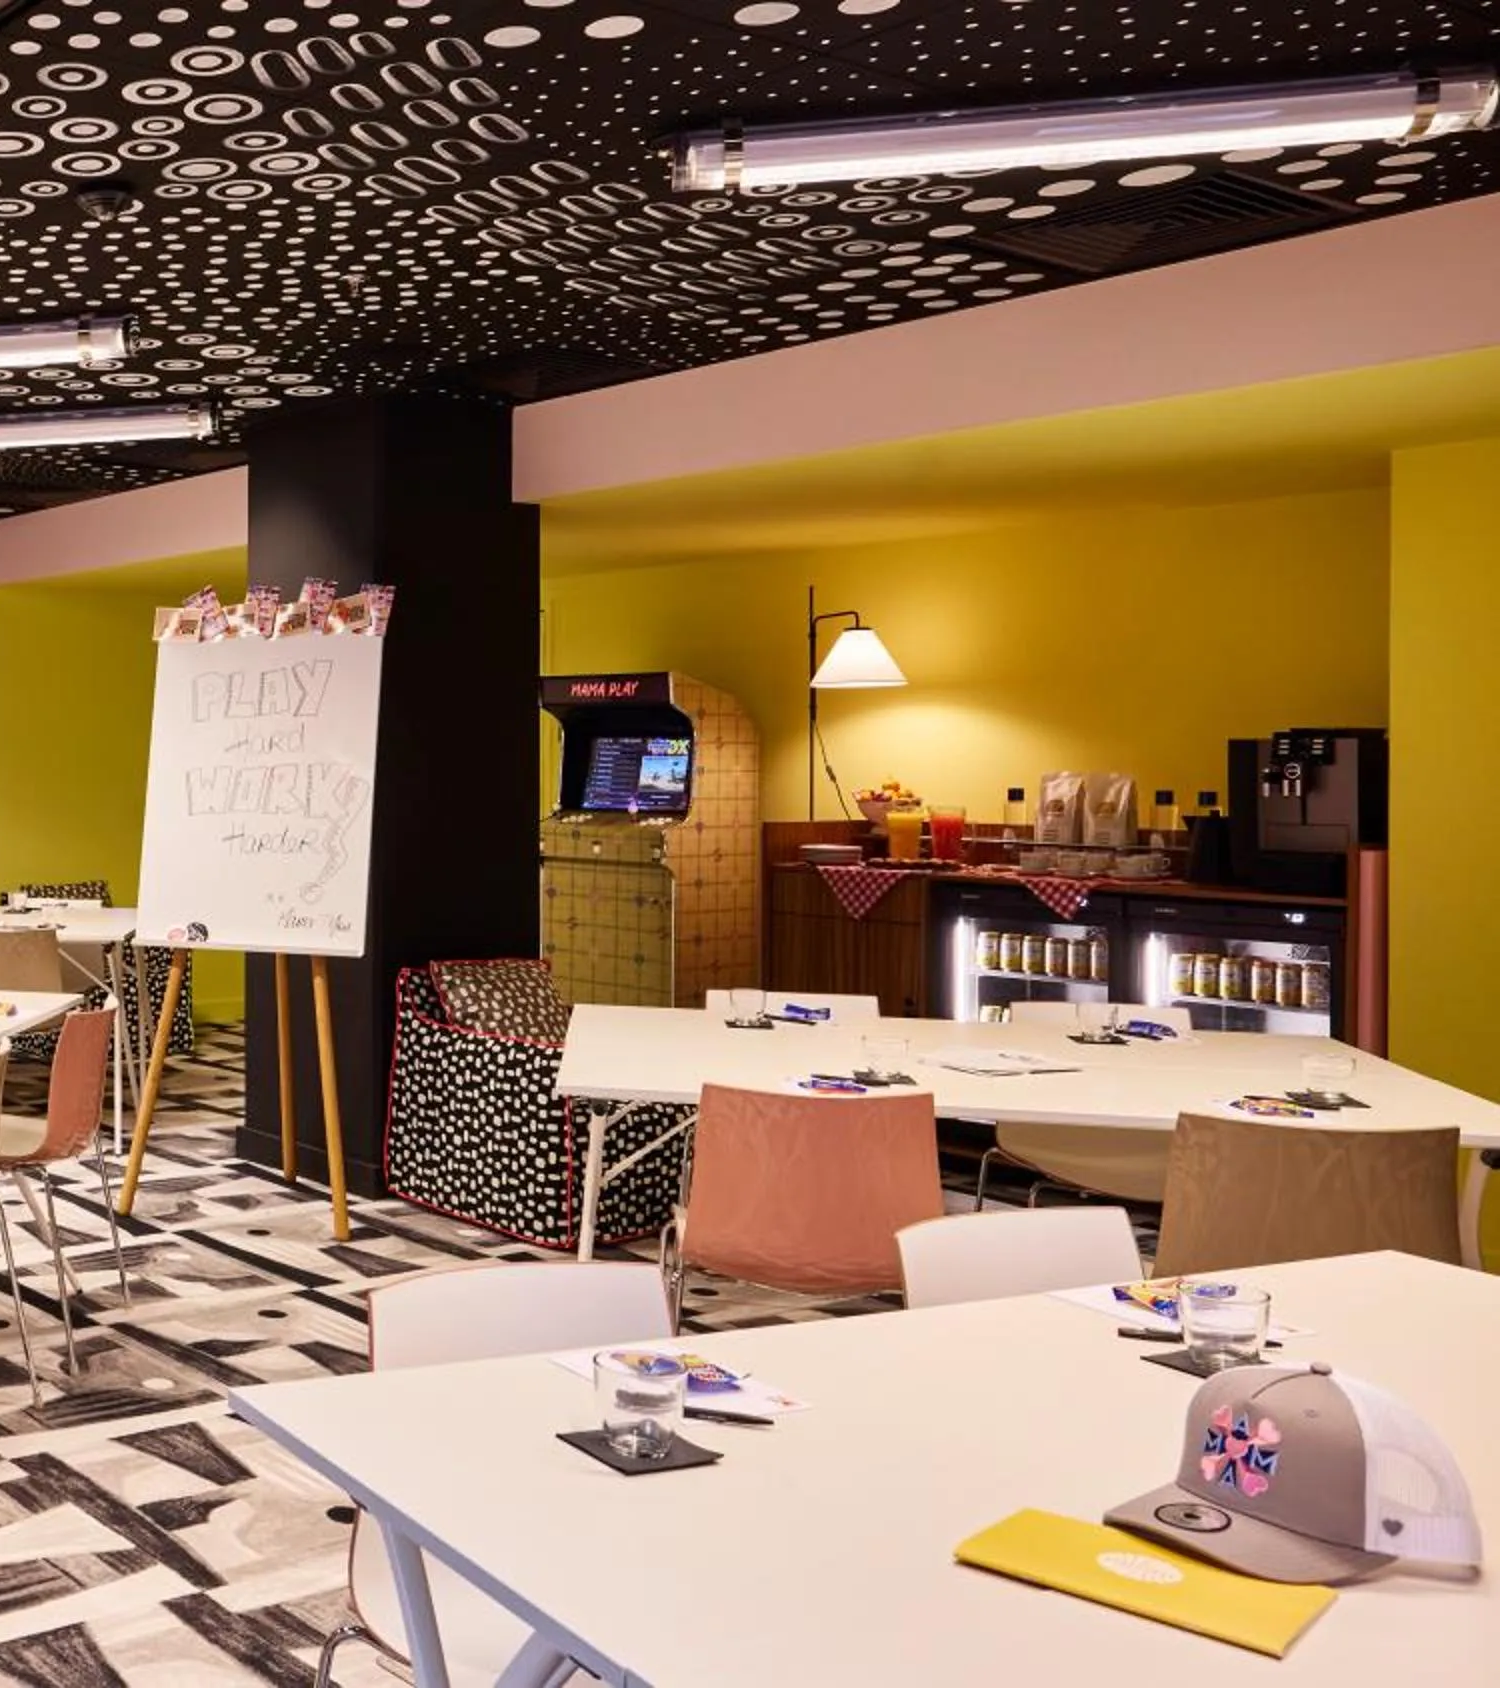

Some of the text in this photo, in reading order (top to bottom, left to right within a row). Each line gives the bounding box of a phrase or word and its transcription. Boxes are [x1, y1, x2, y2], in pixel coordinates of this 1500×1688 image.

[191, 659, 334, 723] PLAY
[570, 679, 640, 698] MAMA PLAY
[185, 763, 354, 819] WORK
